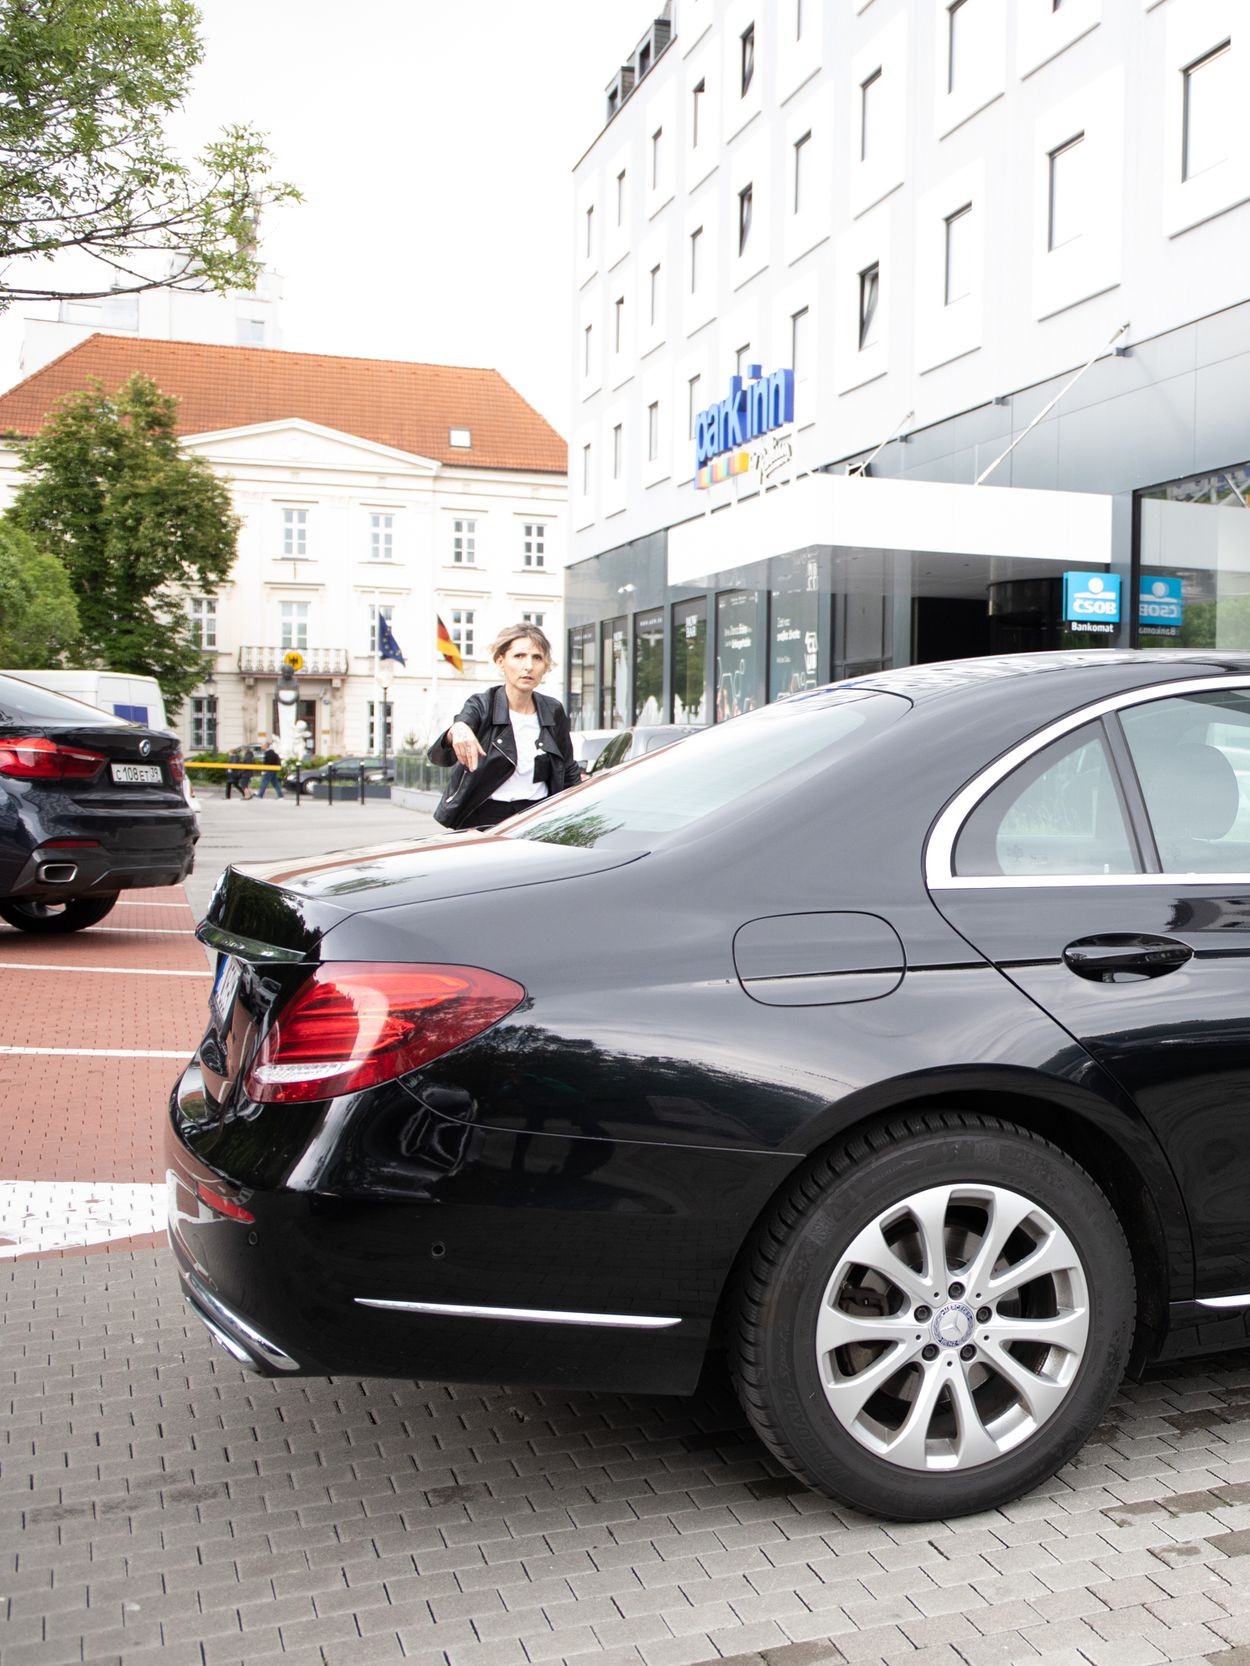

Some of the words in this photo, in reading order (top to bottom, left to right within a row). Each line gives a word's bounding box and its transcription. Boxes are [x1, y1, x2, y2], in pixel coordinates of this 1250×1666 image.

[694, 376, 746, 489] park
[747, 364, 794, 443] inn
[1071, 622, 1114, 633] Bankomat
